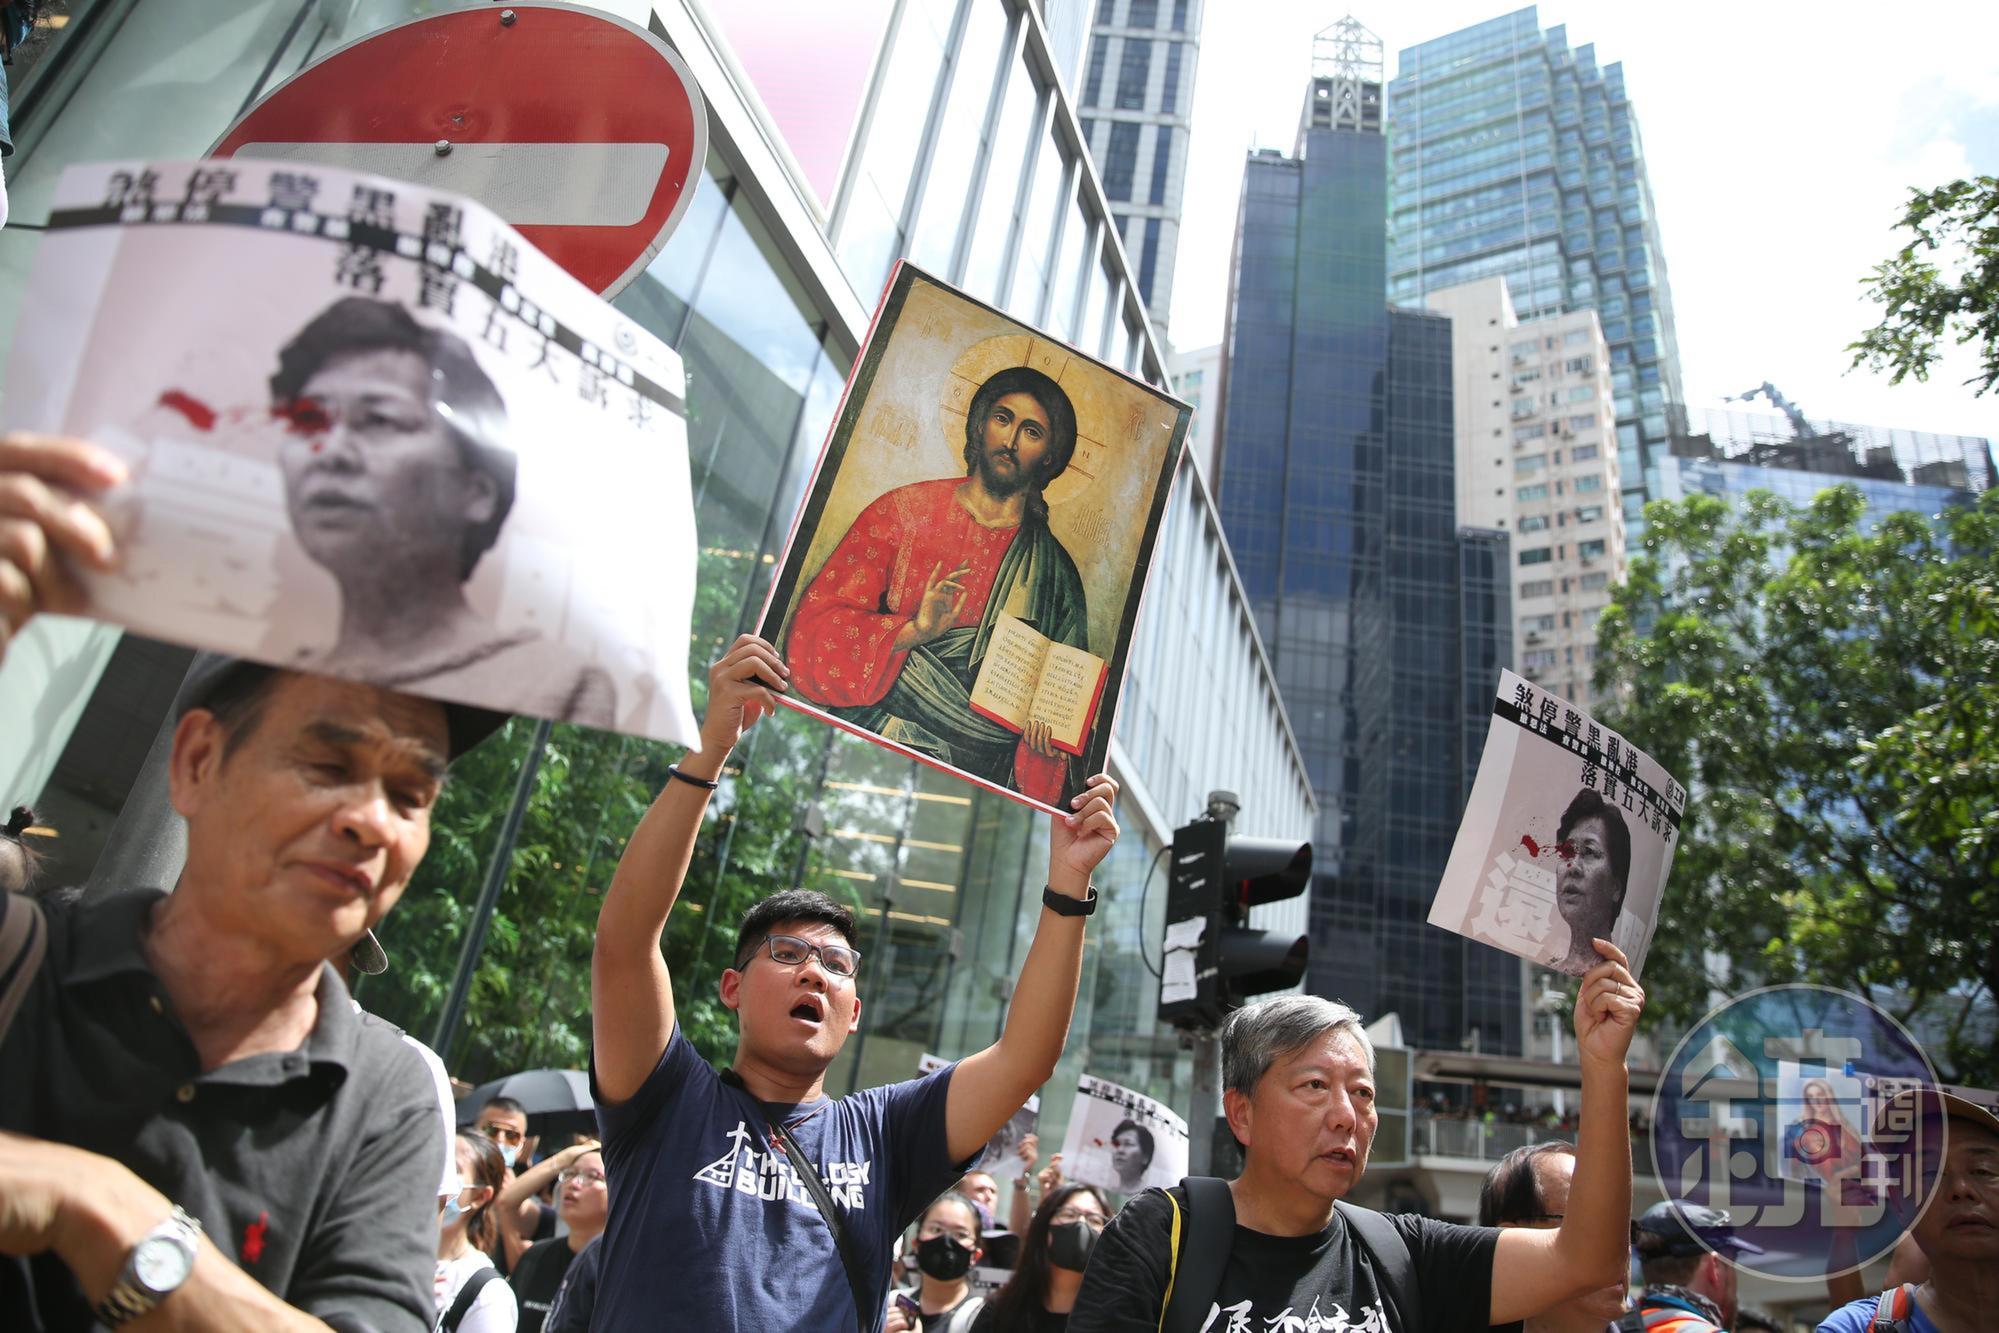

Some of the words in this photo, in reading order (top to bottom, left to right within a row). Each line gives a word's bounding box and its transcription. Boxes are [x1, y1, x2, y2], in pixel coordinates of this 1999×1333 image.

[1514, 683, 1638, 776] 煞停警黑亂港
[1581, 760, 1672, 843] 落實五大訴求
[735, 1166, 865, 1210] BUILDNG
